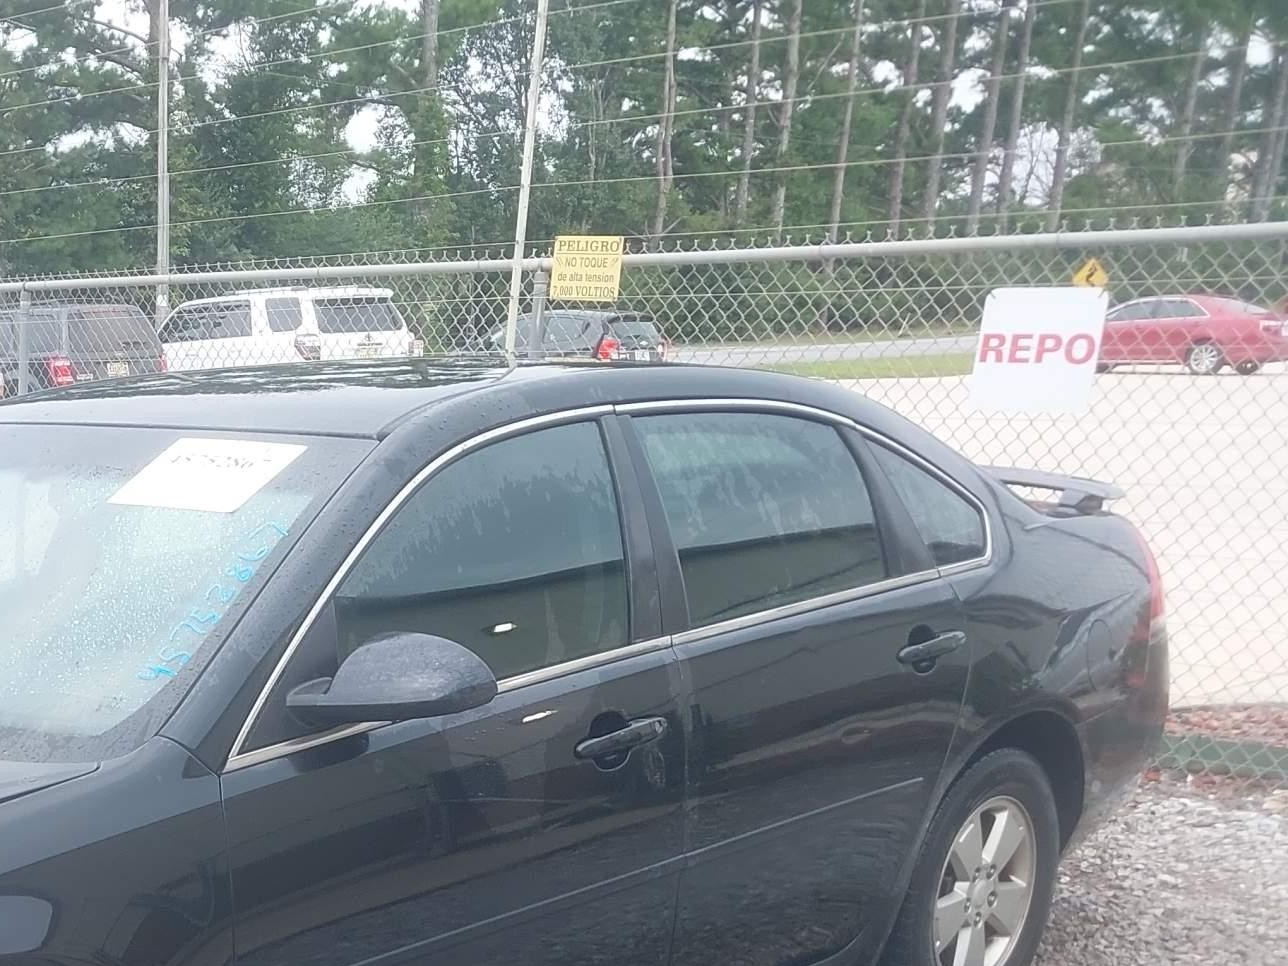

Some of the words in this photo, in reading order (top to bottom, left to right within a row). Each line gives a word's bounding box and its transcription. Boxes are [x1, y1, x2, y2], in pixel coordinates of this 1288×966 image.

[558, 240, 620, 252] PELIGRO
[564, 257, 577, 268] NO
[580, 257, 608, 268] TOQUE
[557, 272, 567, 281] de
[568, 272, 583, 282] alta
[575, 287, 616, 298] VOLTIOS
[978, 333, 1096, 365] REPO
